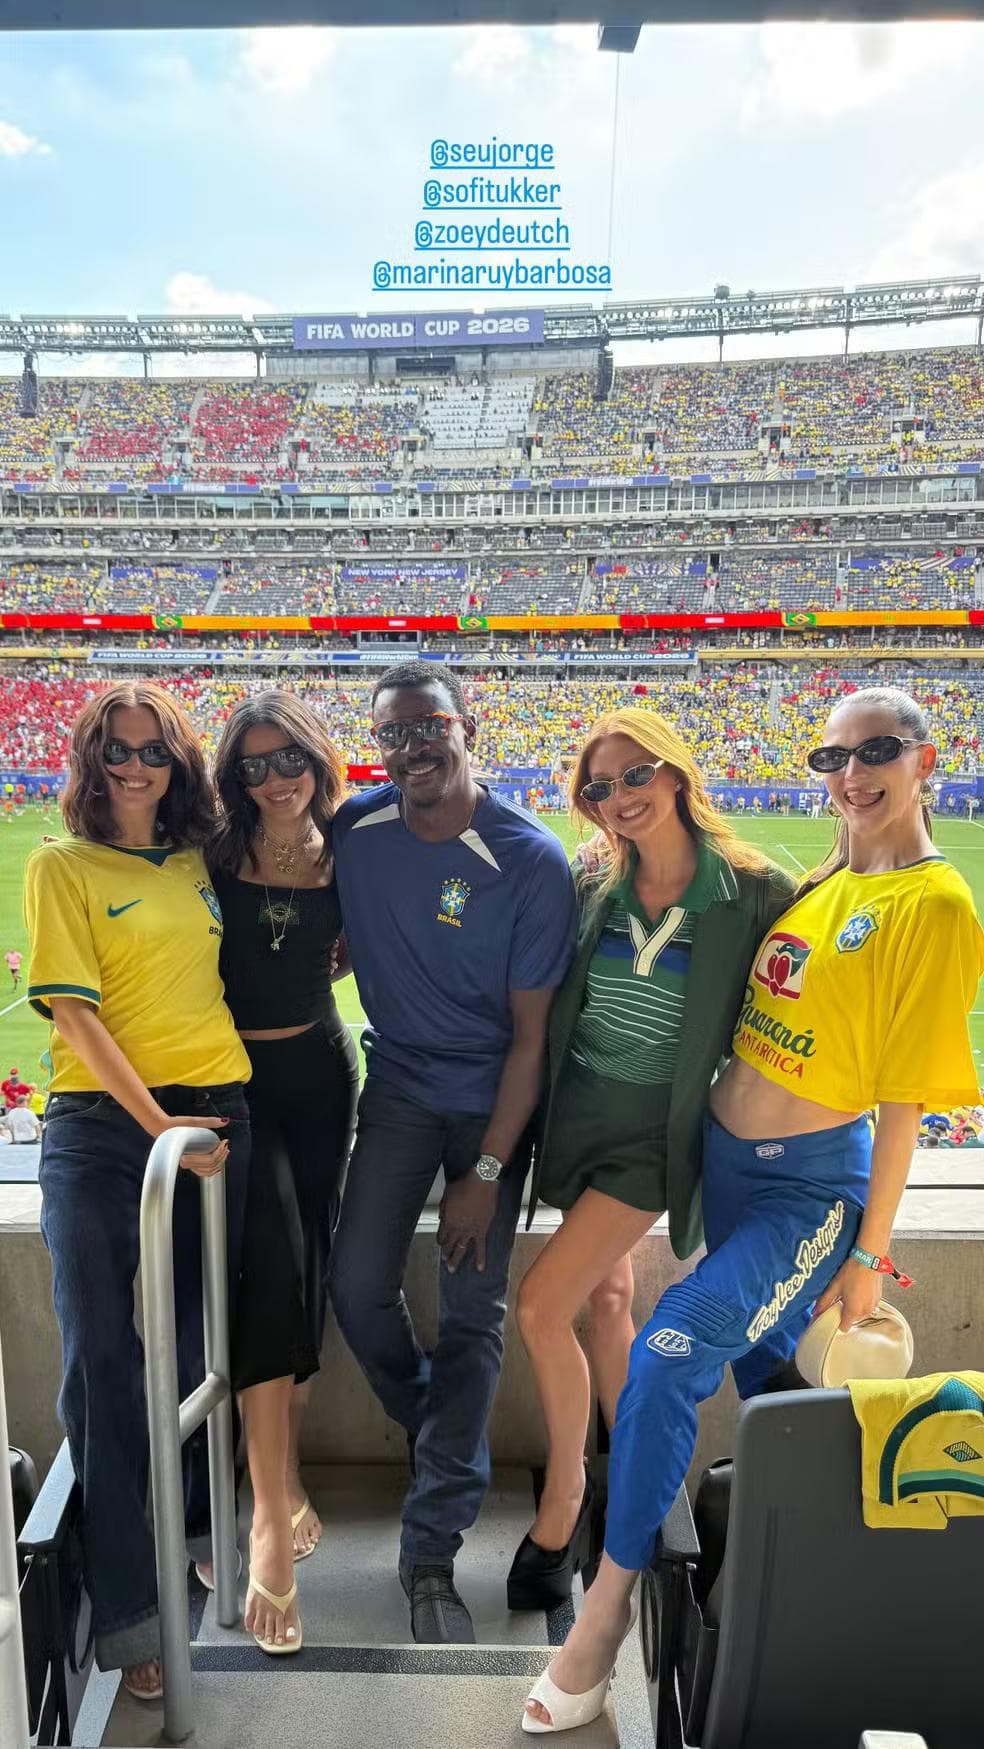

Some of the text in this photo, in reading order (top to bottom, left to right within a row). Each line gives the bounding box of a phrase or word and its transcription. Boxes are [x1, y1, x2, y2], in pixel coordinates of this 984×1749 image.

[306, 317, 530, 340] FIFA WORLD CUP 2026
[348, 567, 458, 577] NEW YORK NEW JERSEY
[574, 653, 595, 661] FIFA
[597, 653, 632, 661] WORLD
[632, 652, 654, 660] CUP
[437, 913, 463, 928] BRASIL
[739, 1031, 805, 1079] ANTARCTICA
[775, 1281, 805, 1311] Lee
